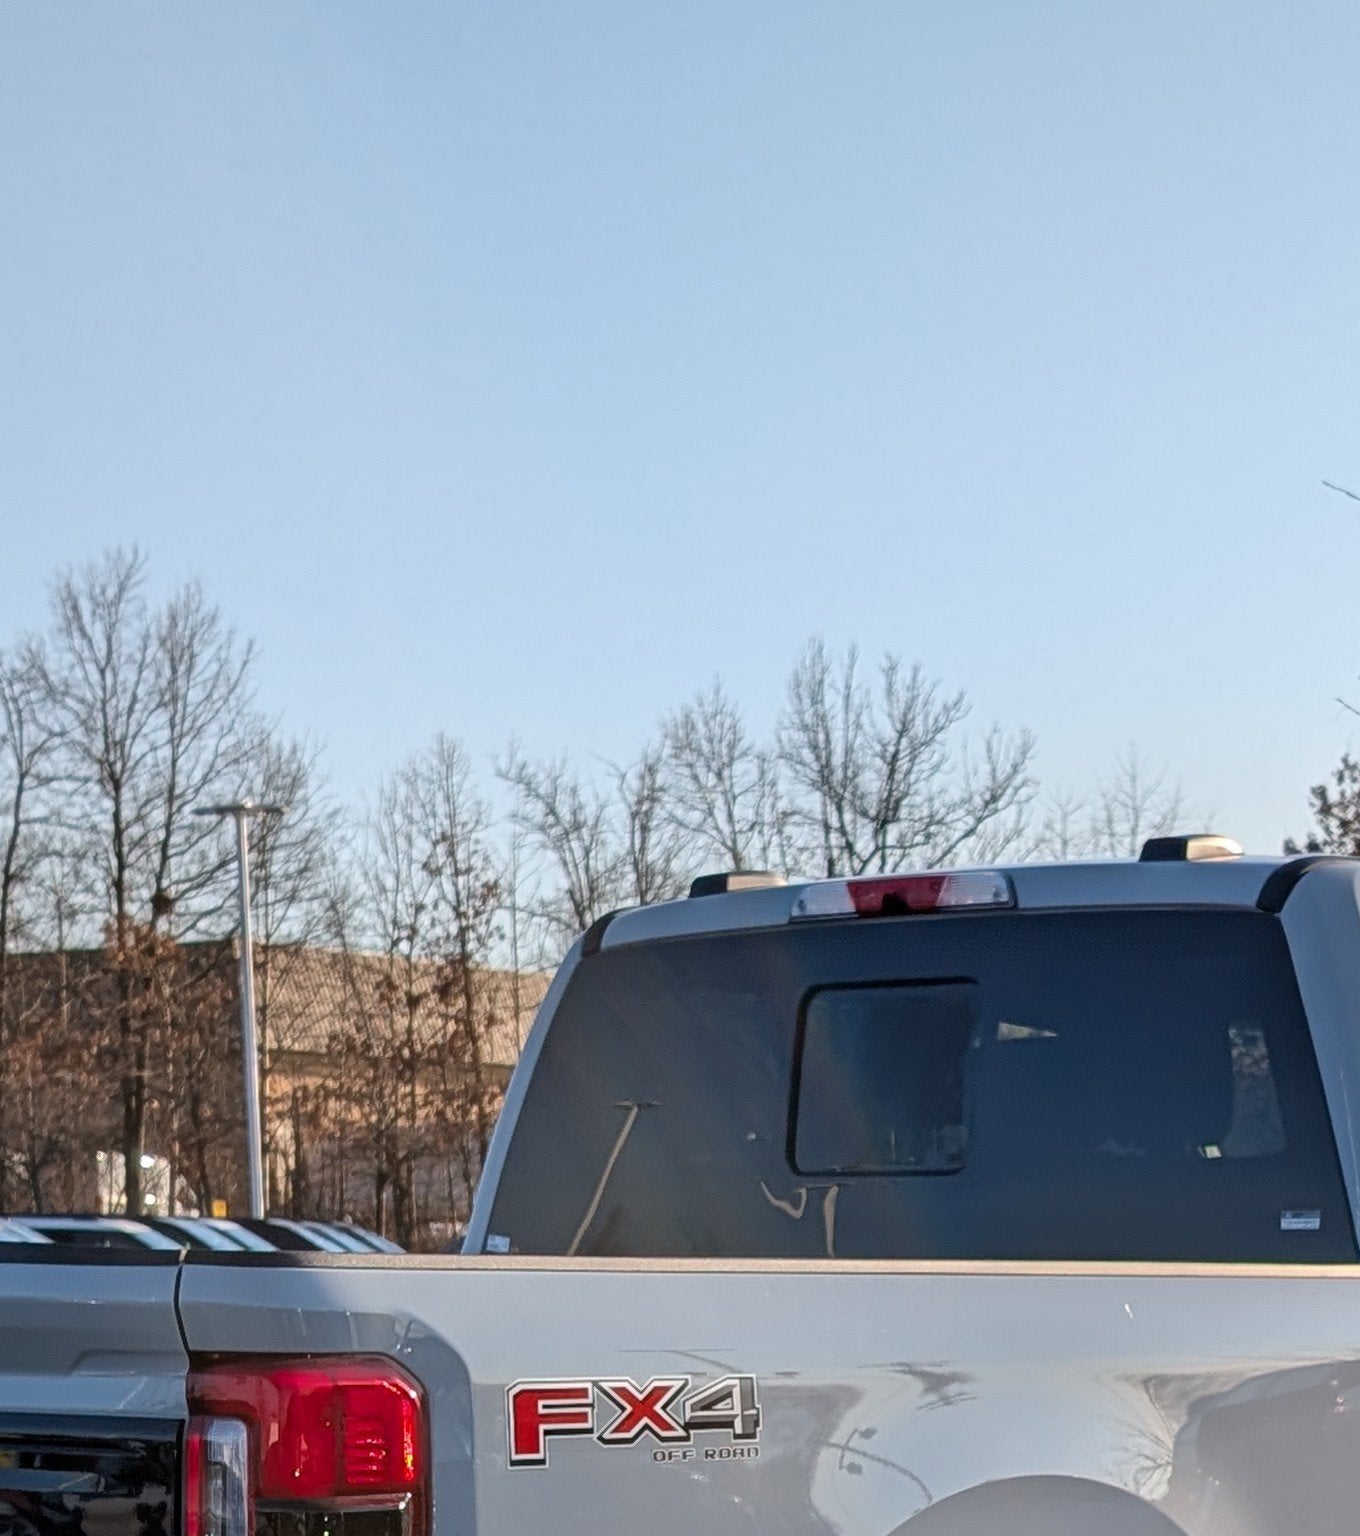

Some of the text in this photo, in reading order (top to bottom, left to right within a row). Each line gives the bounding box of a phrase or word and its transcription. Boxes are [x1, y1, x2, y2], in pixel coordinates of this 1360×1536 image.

[506, 1373, 762, 1470] FX4
[652, 1446, 760, 1463] OFF ROAD
